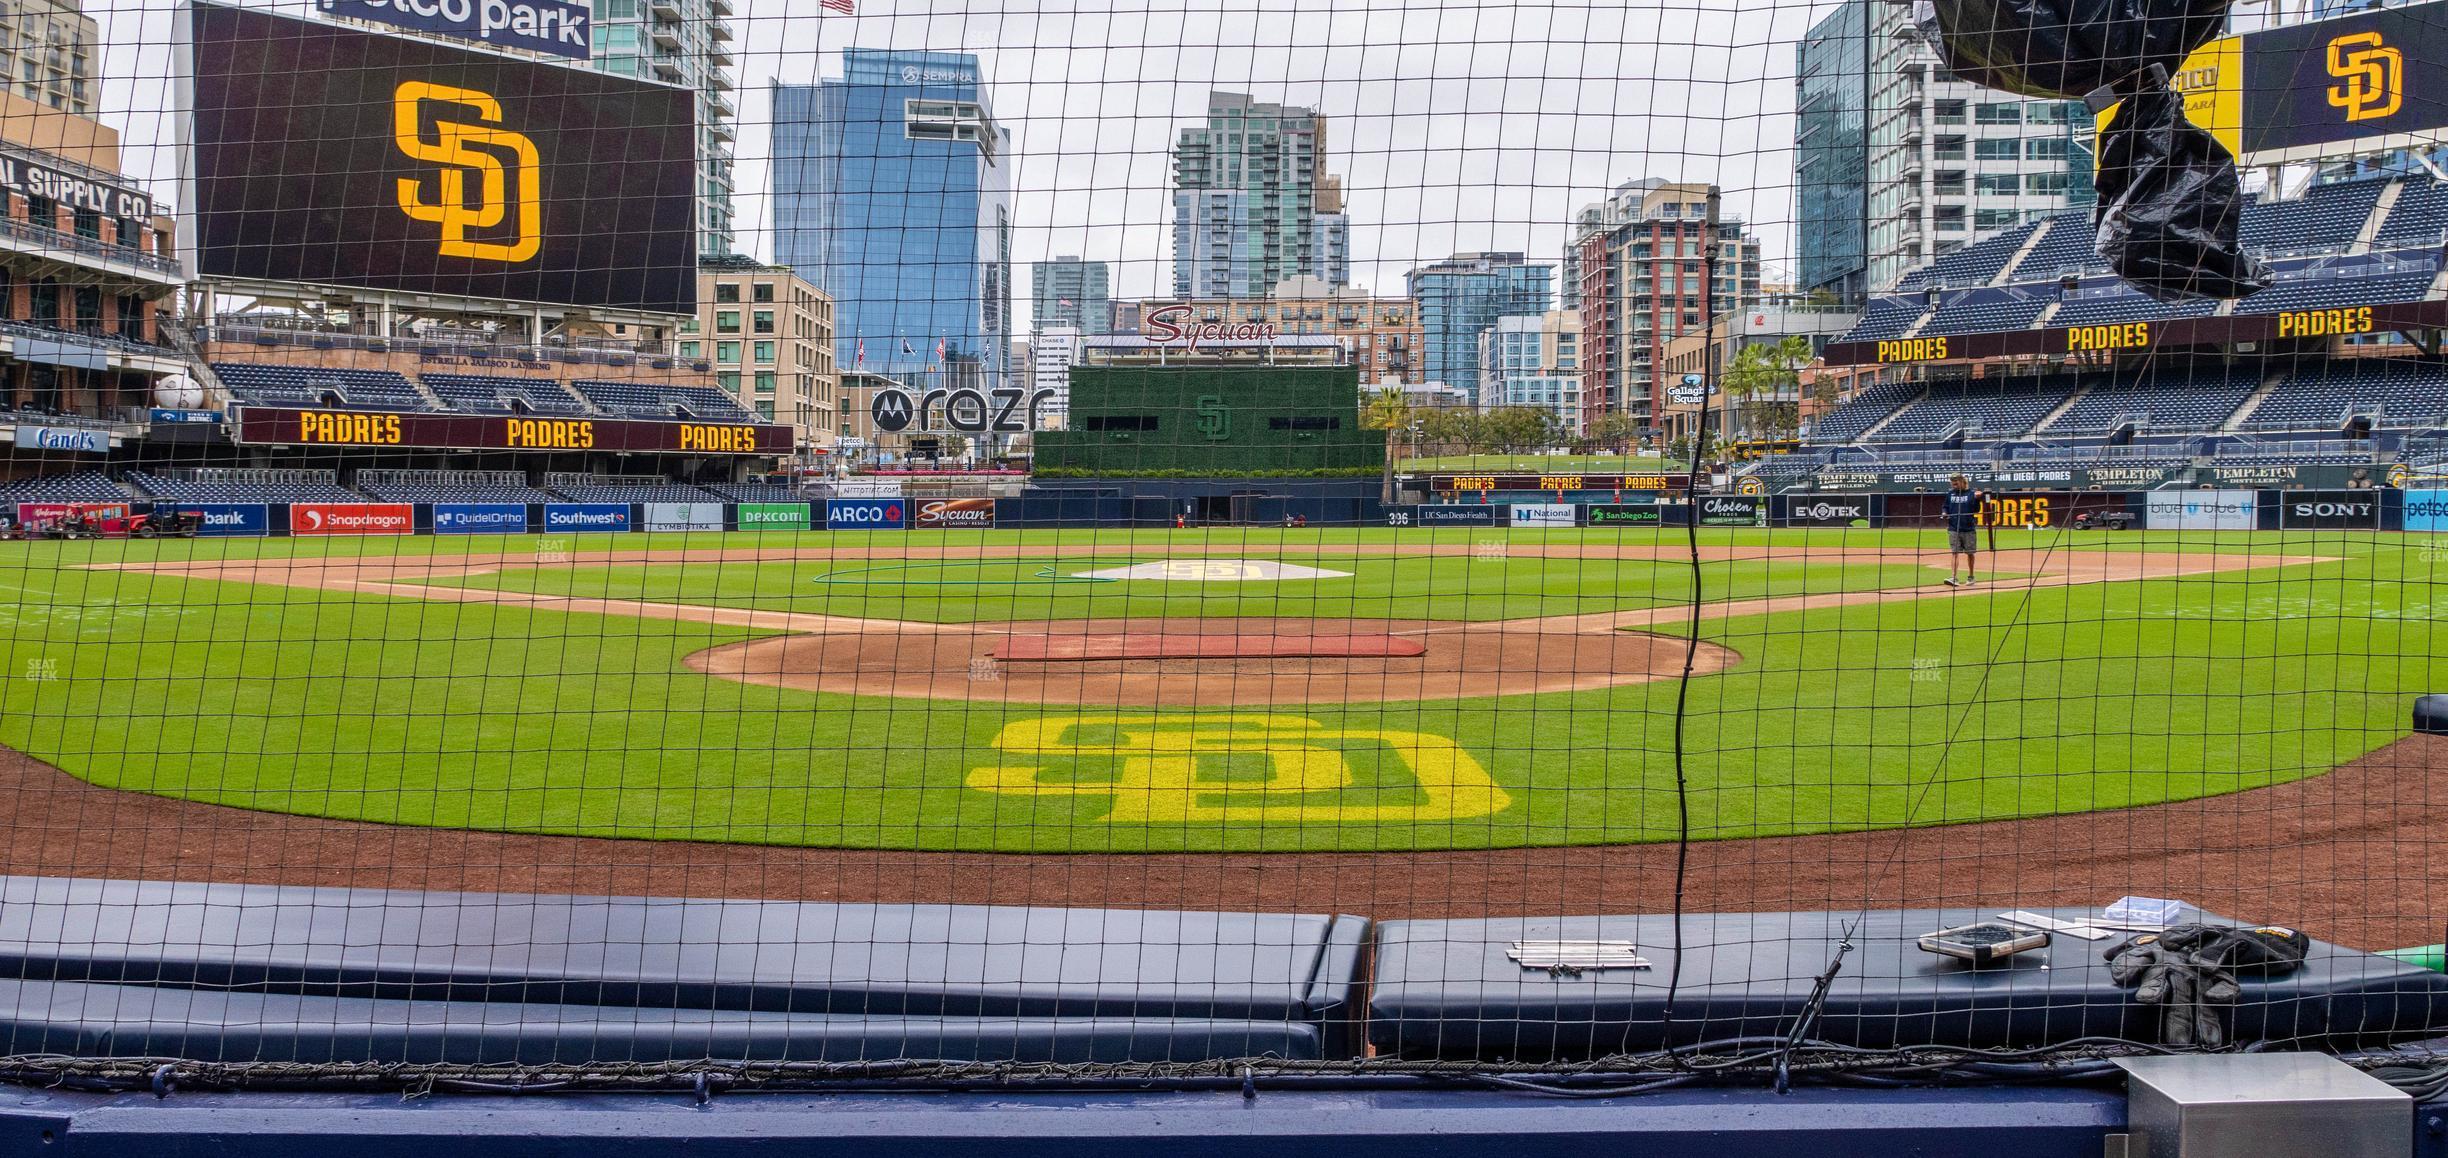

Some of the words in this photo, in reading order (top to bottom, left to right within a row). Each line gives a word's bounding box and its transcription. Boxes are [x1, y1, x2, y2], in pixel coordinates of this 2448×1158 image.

[480, 0, 586, 47] park
[922, 70, 973, 82] SEMPRA
[2326, 31, 2403, 122] SD
[395, 80, 541, 262] SD
[27, 166, 110, 213] SUPPLY
[118, 193, 150, 225] CO.
[1144, 305, 1278, 353] Sycuan
[2278, 306, 2374, 338] PADRES
[2067, 322, 2149, 350] PADRES
[1878, 336, 1948, 362] PADRES
[420, 356, 468, 366] ESTRELLA
[471, 359, 508, 368] JALISCO
[510, 361, 551, 371] LANDING
[1674, 395, 1704, 404] Squar
[920, 387, 1056, 432] razr
[301, 411, 401, 443] PADRES
[507, 419, 594, 448] PADRES
[680, 424, 755, 451] PADRES
[1816, 474, 1879, 484] TEMPLETON
[1995, 472, 2011, 481] SAN
[2013, 472, 2036, 481] DIEGO
[2038, 471, 2071, 481] PADRES
[2087, 468, 2164, 481] TEMPLETON
[2213, 467, 2297, 479] TEMPLETON
[1453, 477, 1495, 490] PADRES
[1540, 477, 1582, 490] PADRES
[1625, 477, 1667, 489] PADRES
[1534, 509, 1570, 517] National
[1704, 498, 1752, 513] Chosen
[1795, 503, 1861, 520] EVOTEK
[1975, 498, 2048, 526] ADRES
[2151, 501, 2183, 514] blue
[2295, 503, 2372, 517] SONY
[327, 512, 406, 527] Snapdragon
[455, 512, 522, 525] QuidelOrtho
[550, 511, 616, 525] Southwest
[830, 507, 883, 522] ARCO
[921, 501, 985, 526] Sycuan
[1388, 512, 1409, 525] 396
[1436, 511, 1448, 519] San
[1449, 511, 1467, 520] Diego
[1467, 511, 1488, 519] Health
[1621, 511, 1642, 520] Diego
